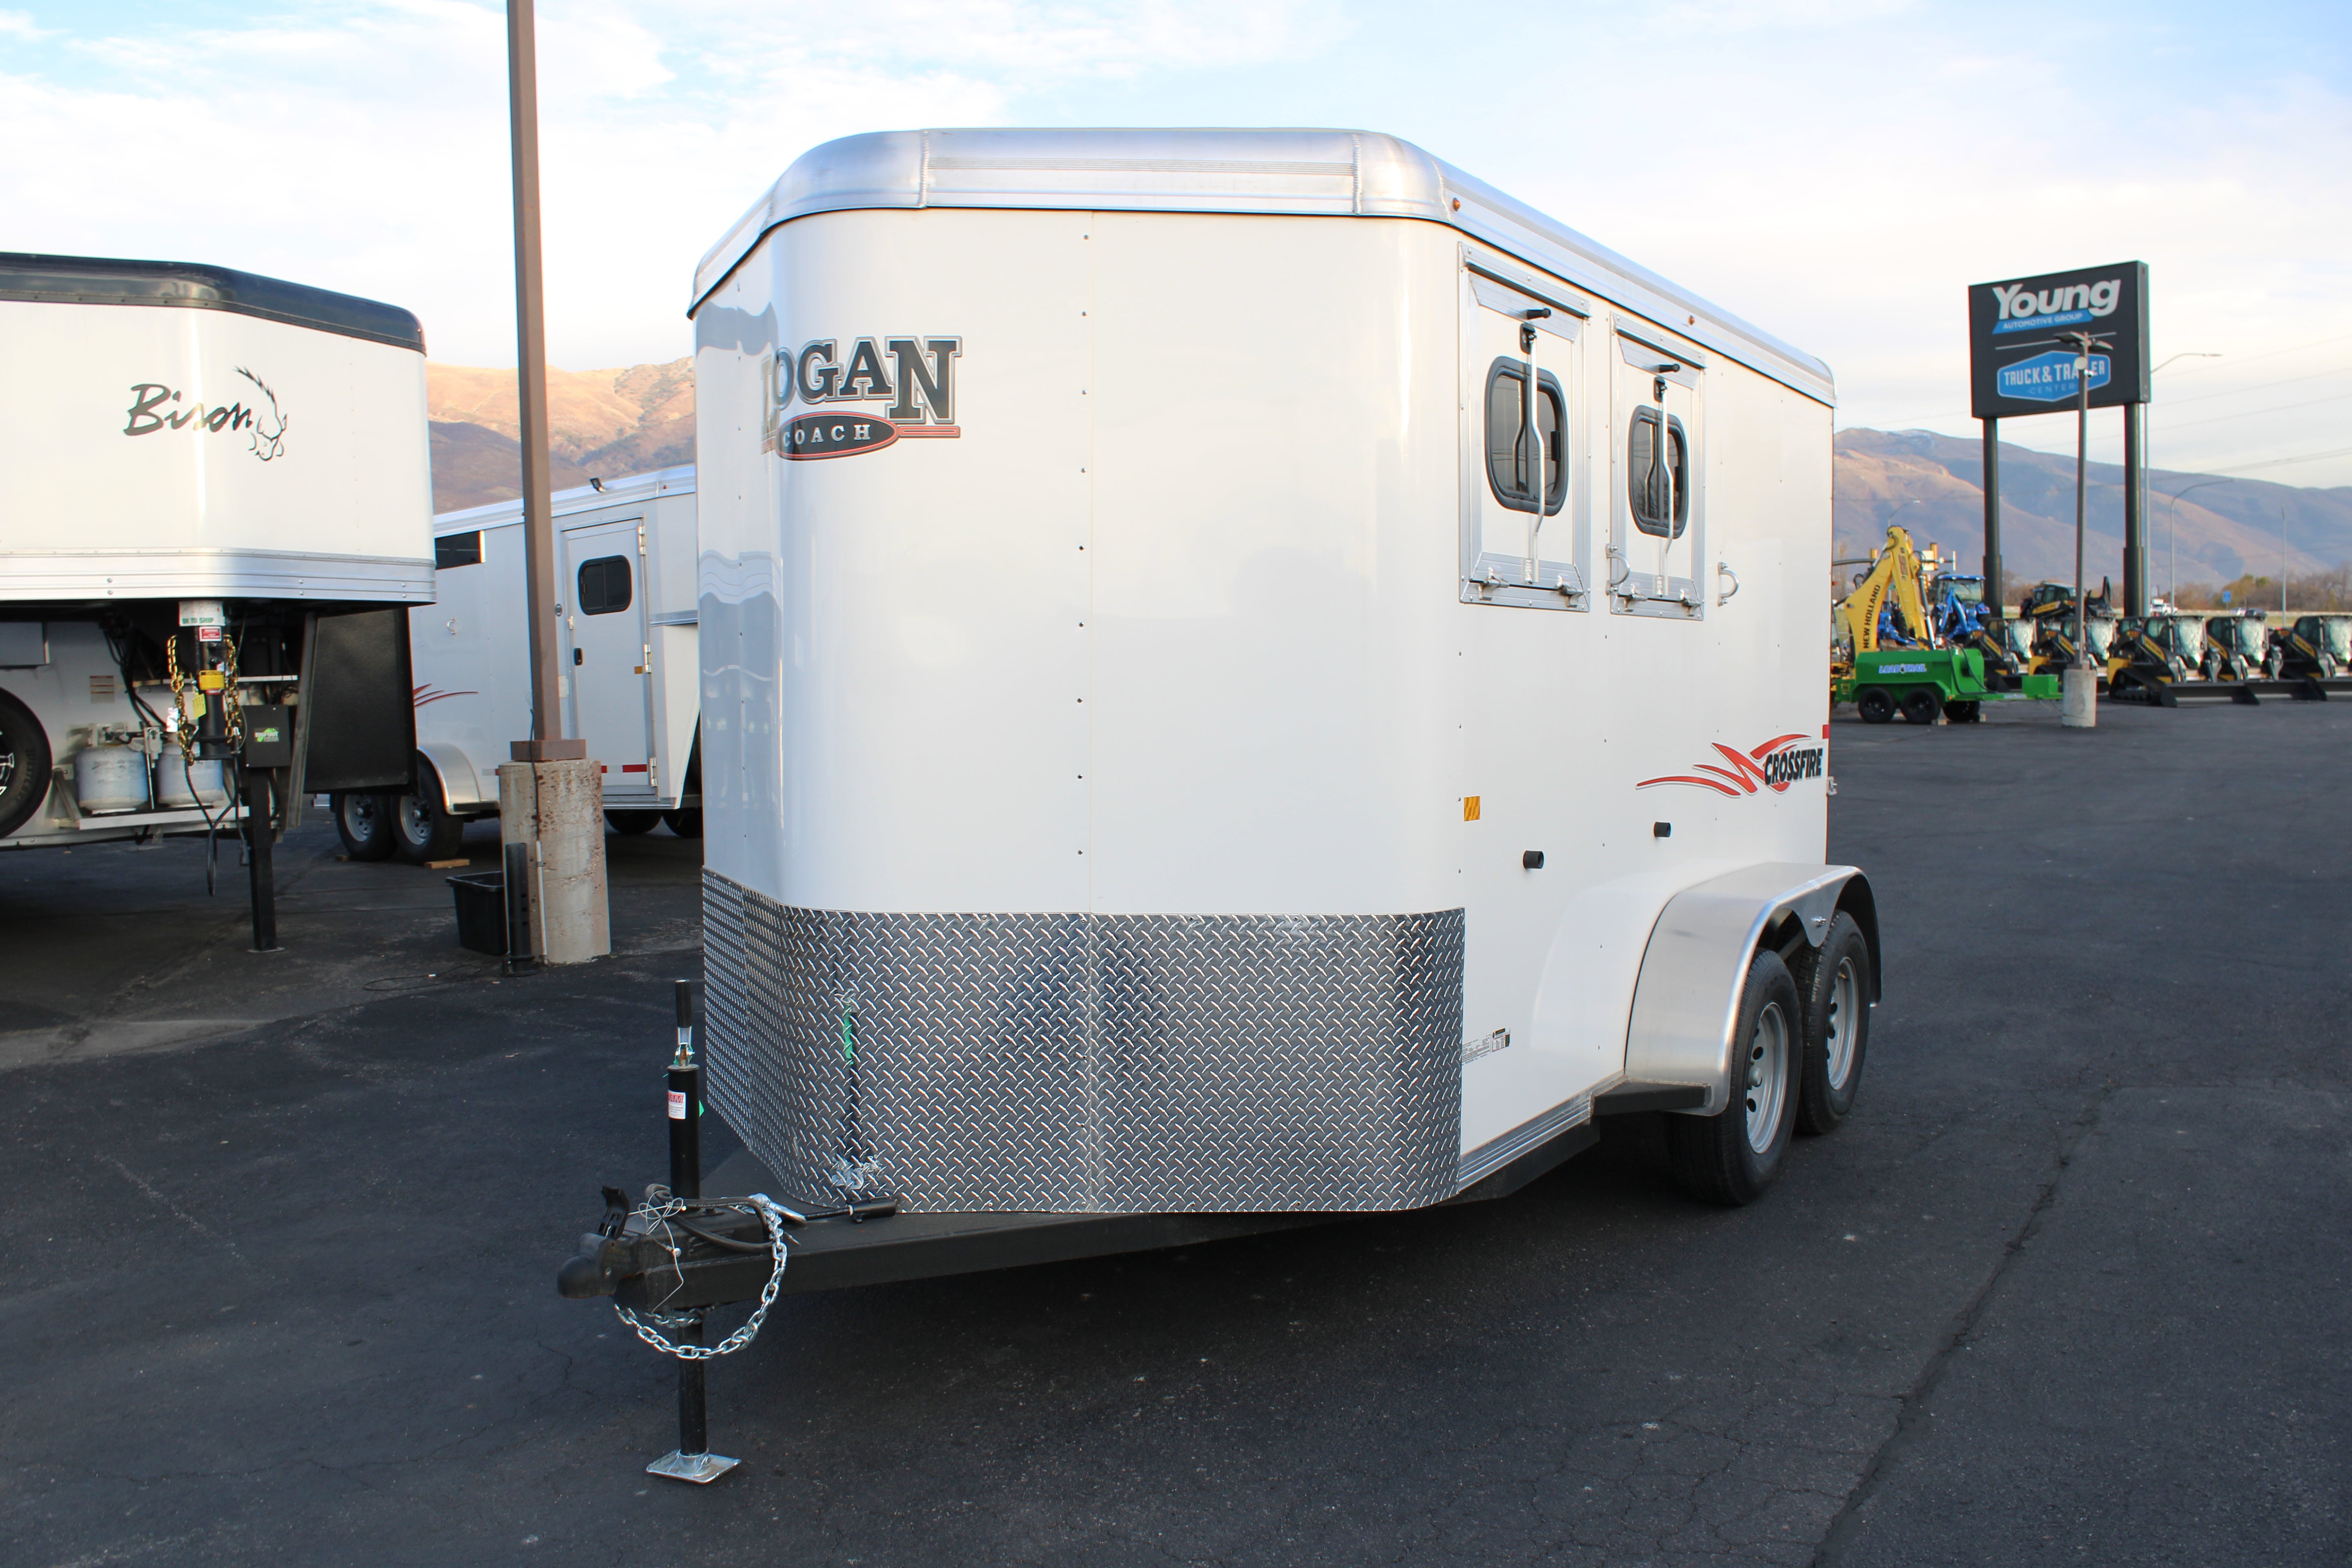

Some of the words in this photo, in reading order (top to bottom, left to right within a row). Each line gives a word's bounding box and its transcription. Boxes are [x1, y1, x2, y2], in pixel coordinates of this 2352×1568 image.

[1992, 279, 2121, 320] Young
[2003, 316, 2053, 330] AUTOMOTIVE
[2055, 312, 2083, 323] GROUP
[761, 336, 962, 434] LOGAN
[2004, 367, 2040, 386] TRUCK
[2042, 365, 2052, 383] &
[2054, 360, 2105, 381] TRAER
[124, 384, 252, 436] Bison
[782, 424, 871, 447] COACH
[1864, 584, 1881, 626] HOLLAND
[1879, 665, 1900, 674] LOAD
[1904, 664, 1927, 672] TRAIL
[1764, 748, 1823, 785] CROSSFIRE
